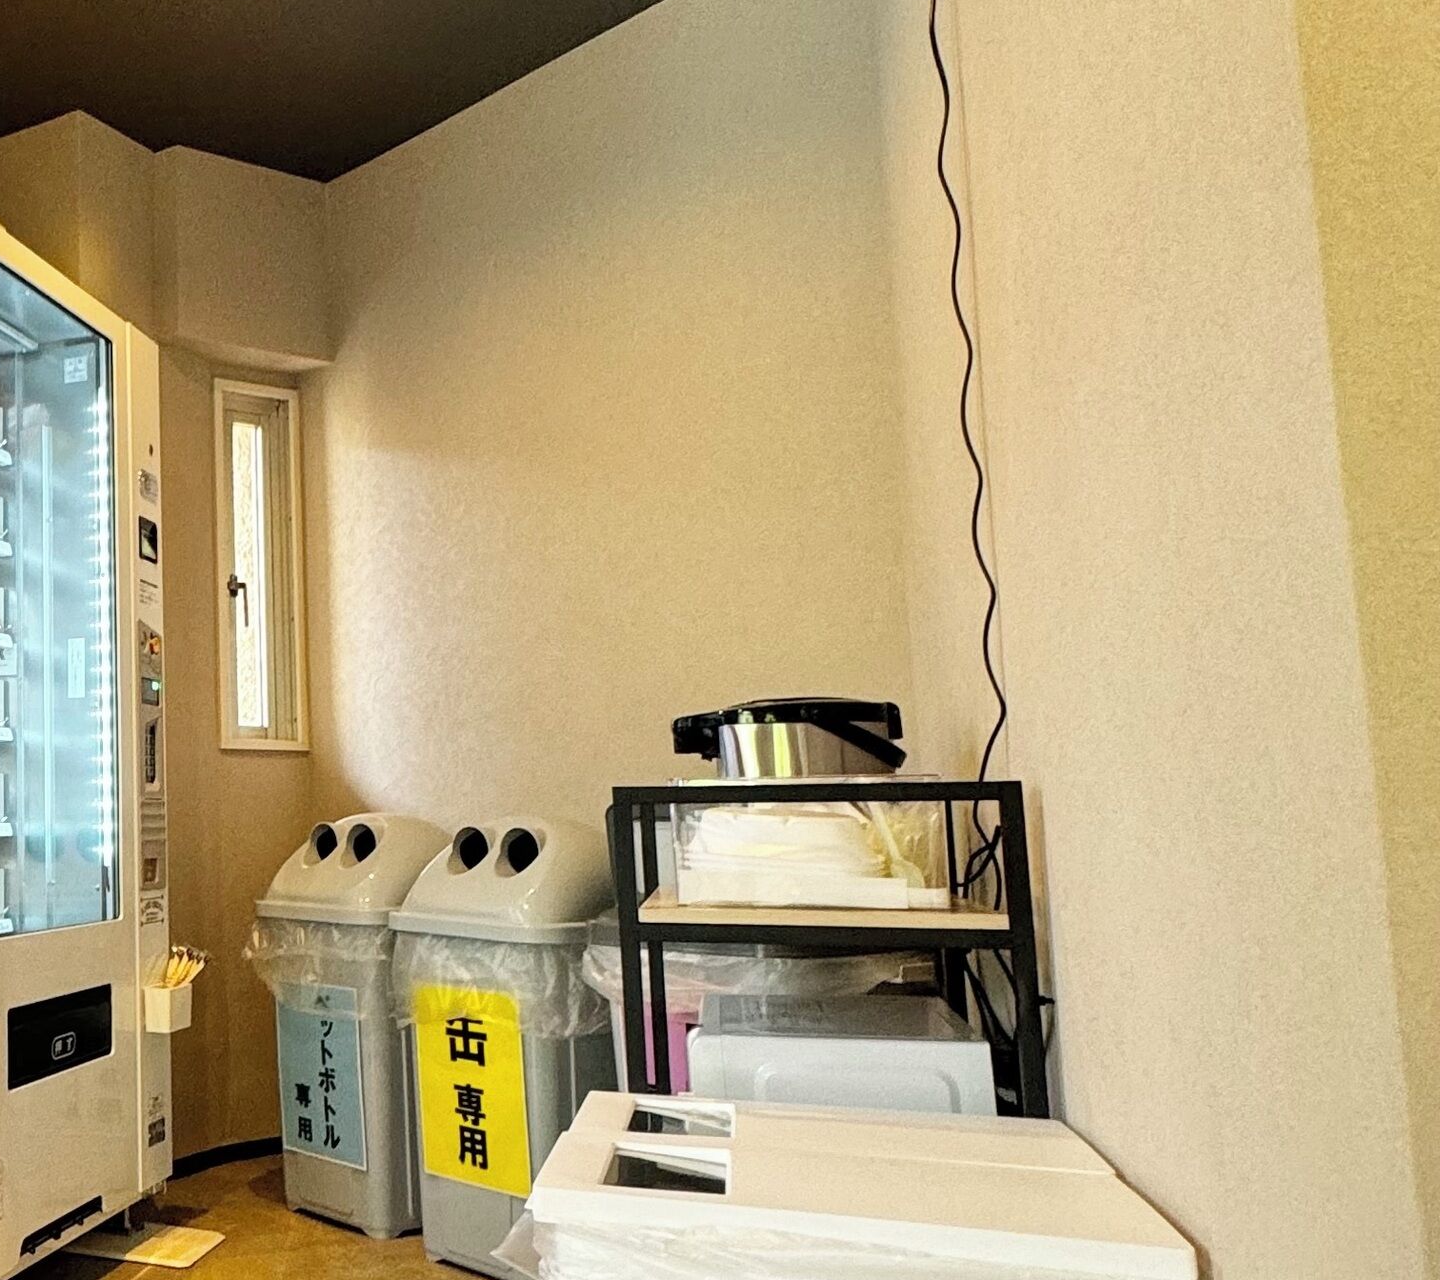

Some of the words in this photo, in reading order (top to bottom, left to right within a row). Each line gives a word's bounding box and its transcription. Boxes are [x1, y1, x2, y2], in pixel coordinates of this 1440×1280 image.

[314, 994, 341, 1150] ペットボトル
[445, 1016, 489, 1068] 缶
[295, 1082, 314, 1143] 専用
[453, 1083, 490, 1171] 専用
